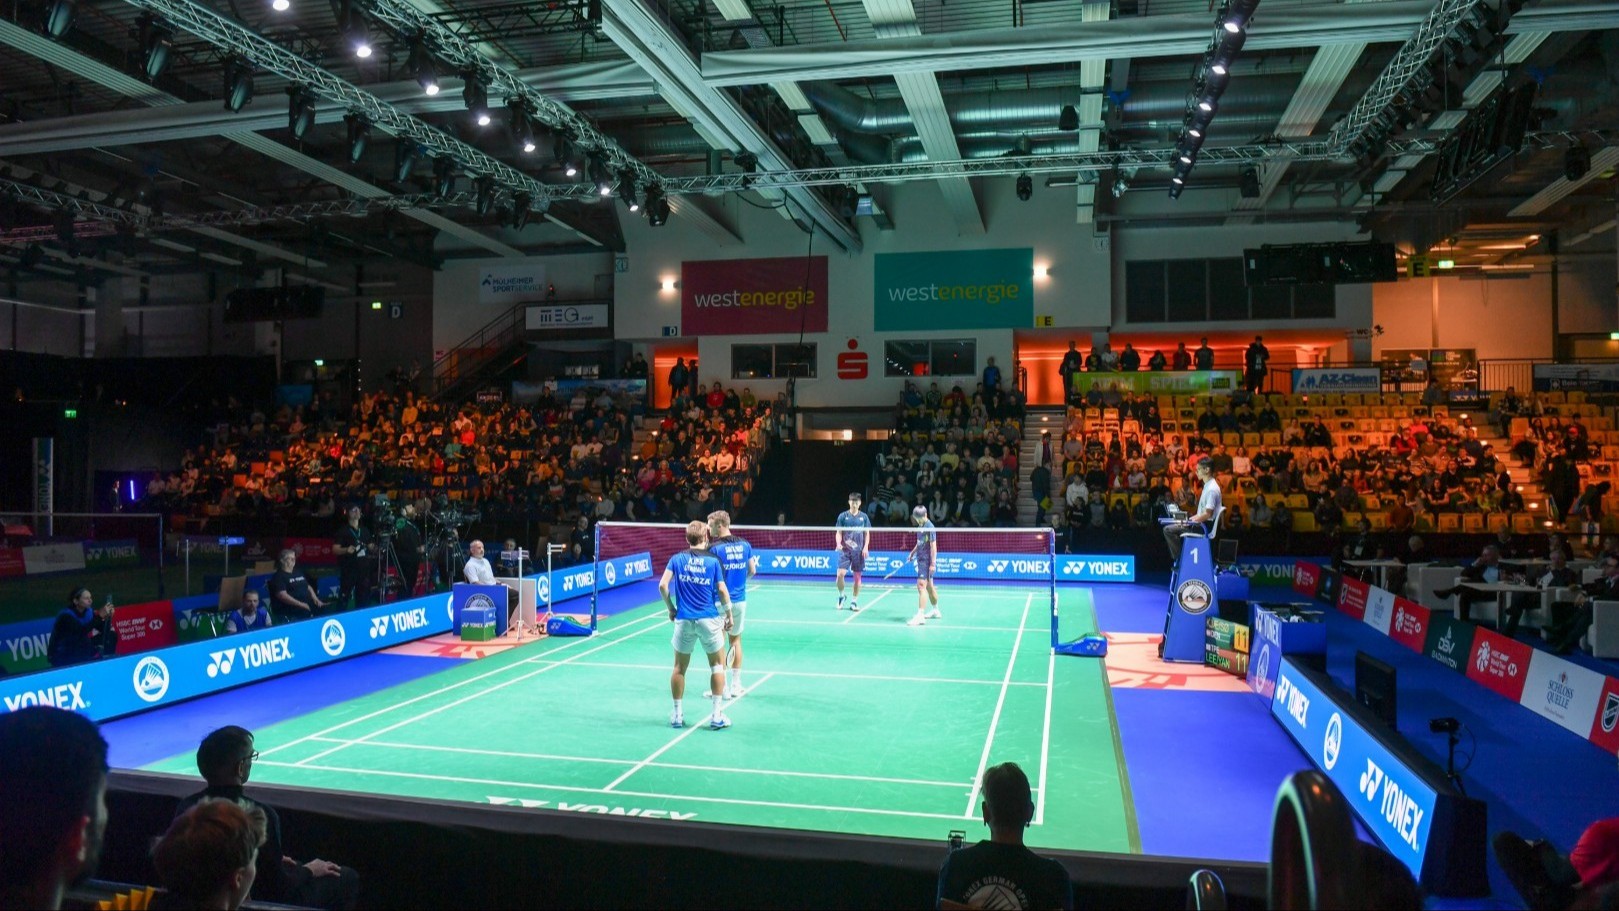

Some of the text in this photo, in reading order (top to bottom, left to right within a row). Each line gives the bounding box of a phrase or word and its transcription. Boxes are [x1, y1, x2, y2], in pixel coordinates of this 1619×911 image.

[1413, 262, 1424, 276] E
[694, 286, 815, 310] westenergie
[889, 279, 1019, 304] westenergie
[391, 306, 401, 318] D
[793, 555, 830, 569] YONEX
[1190, 547, 1199, 564] 1
[634, 559, 651, 574] YONEX
[1012, 560, 1051, 574] YONEX
[1088, 561, 1128, 576] YONEX
[1263, 564, 1296, 579] YON
[574, 570, 594, 588] YONEX
[390, 607, 428, 633] YONEX
[6, 632, 51, 661] YON
[1236, 628, 1247, 649] 11
[238, 636, 292, 670] YONEX
[1235, 652, 1247, 673] 11
[1431, 649, 1458, 670] BADMINTON
[1547, 680, 1574, 699] SCHLOSS
[1287, 682, 1310, 729] YONEX
[1546, 690, 1570, 710] QUELLE
[1381, 774, 1424, 851] YONEX
[982, 876, 1017, 890] GERMAN
